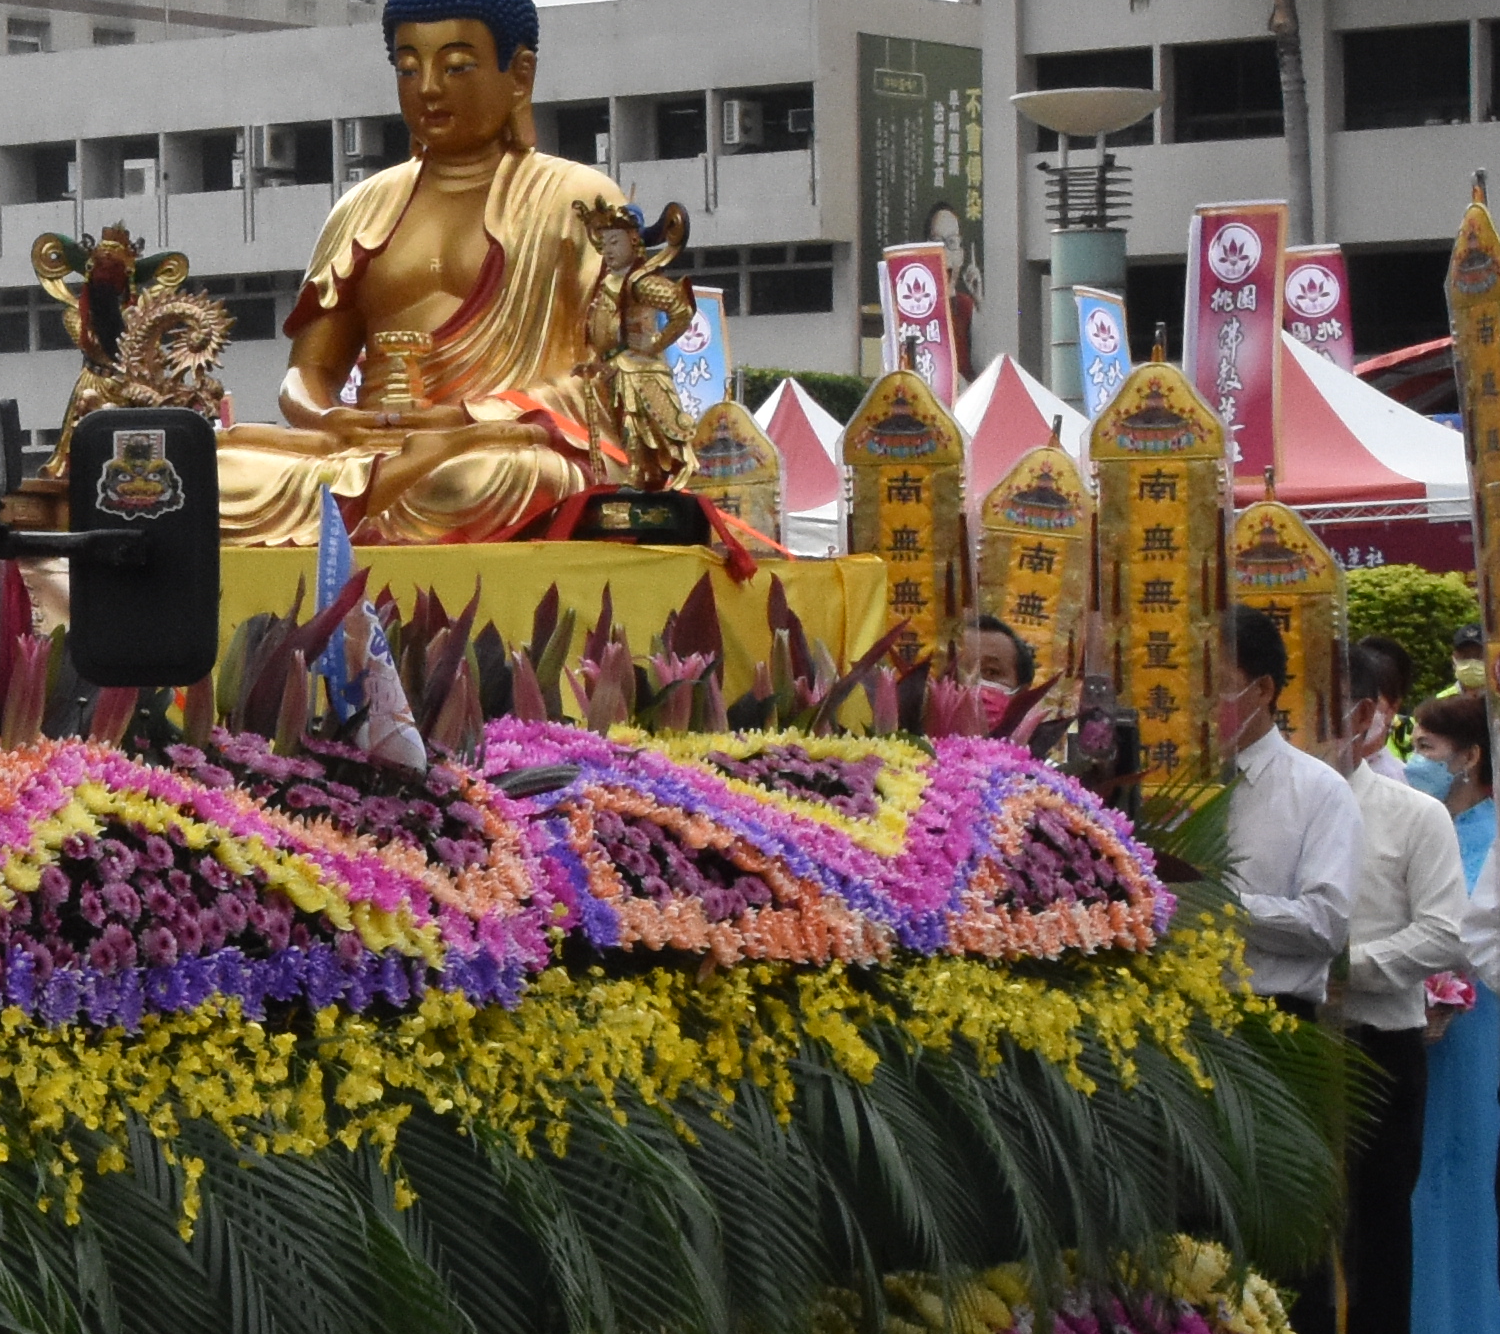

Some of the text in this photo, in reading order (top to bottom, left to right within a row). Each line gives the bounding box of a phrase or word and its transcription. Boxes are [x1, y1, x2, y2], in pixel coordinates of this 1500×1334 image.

[1210, 283, 1258, 312] 桃園
[898, 319, 942, 345] 桃園
[672, 355, 712, 387] 台北
[1088, 356, 1124, 387] 台北
[1128, 468, 1182, 773] 南無無量壽佛
